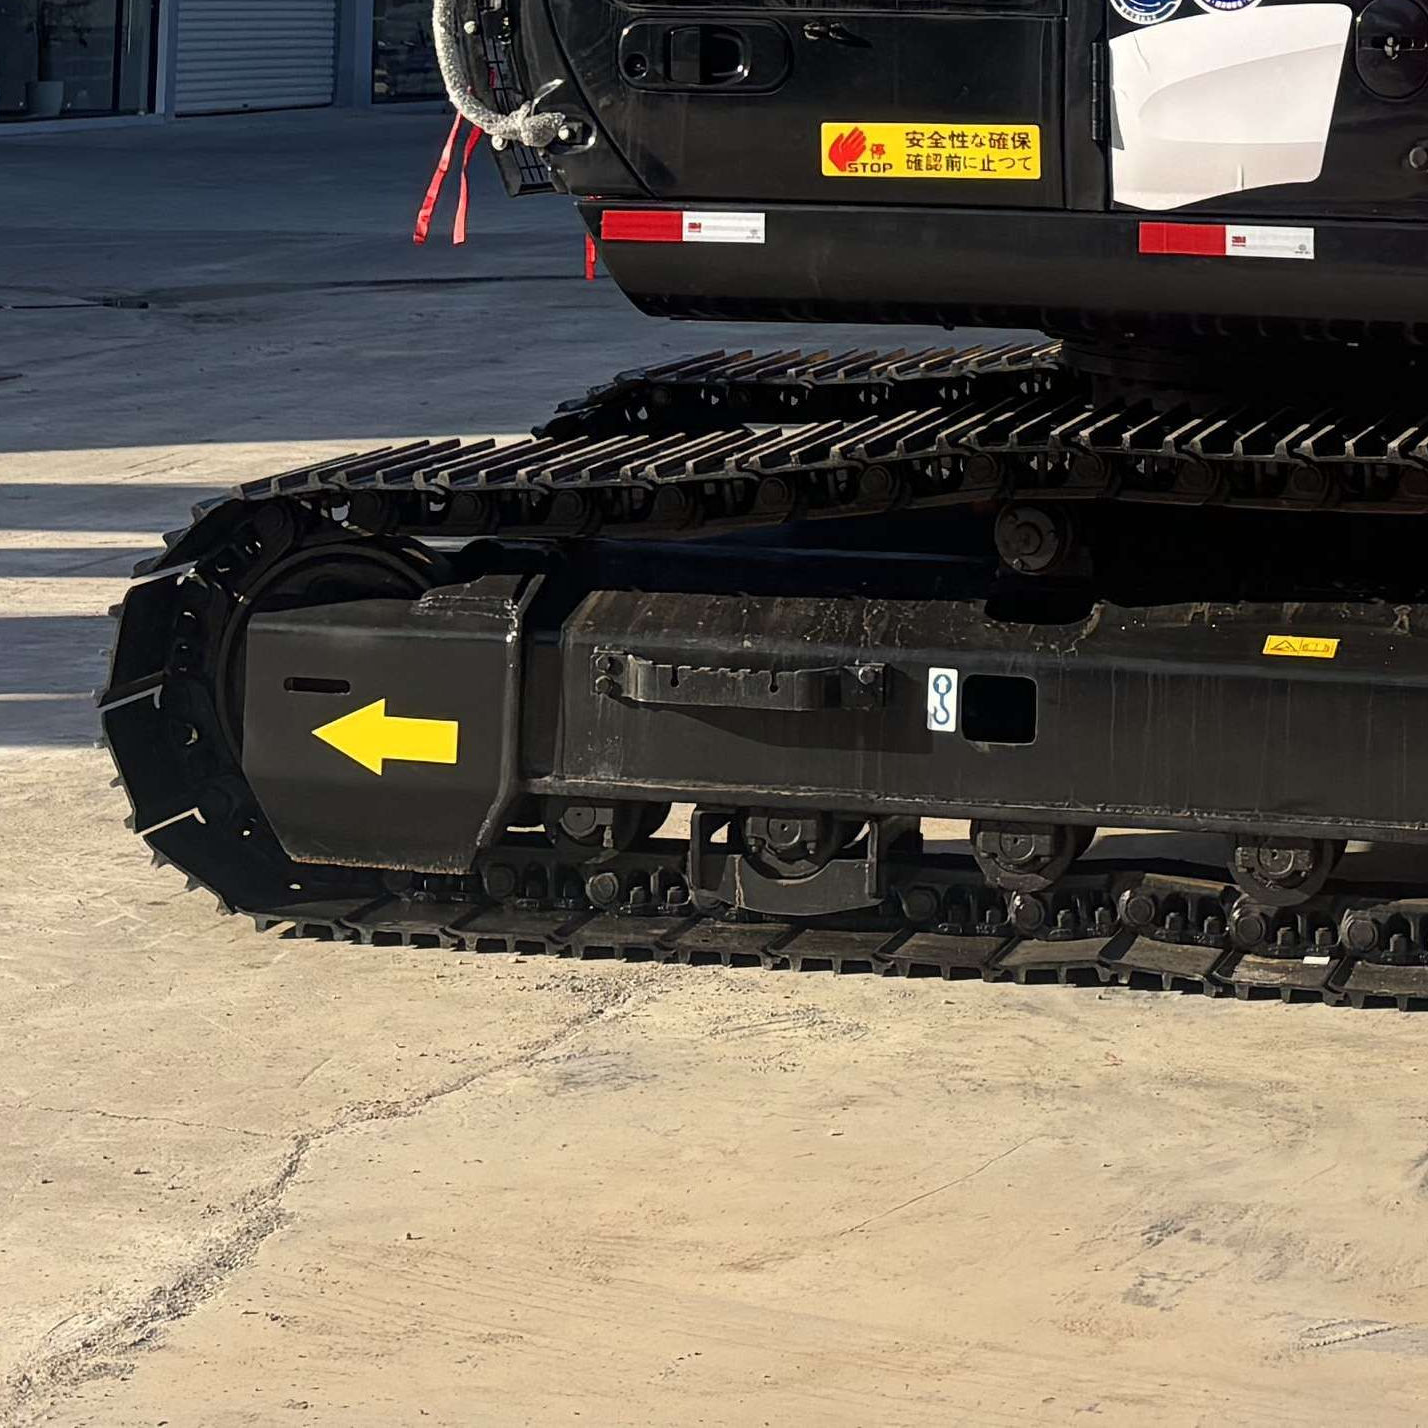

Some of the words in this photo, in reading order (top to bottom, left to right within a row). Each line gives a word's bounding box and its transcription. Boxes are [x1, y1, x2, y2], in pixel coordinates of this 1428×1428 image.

[905, 130, 1032, 150] 安全性な確保
[848, 162, 893, 174] STOP
